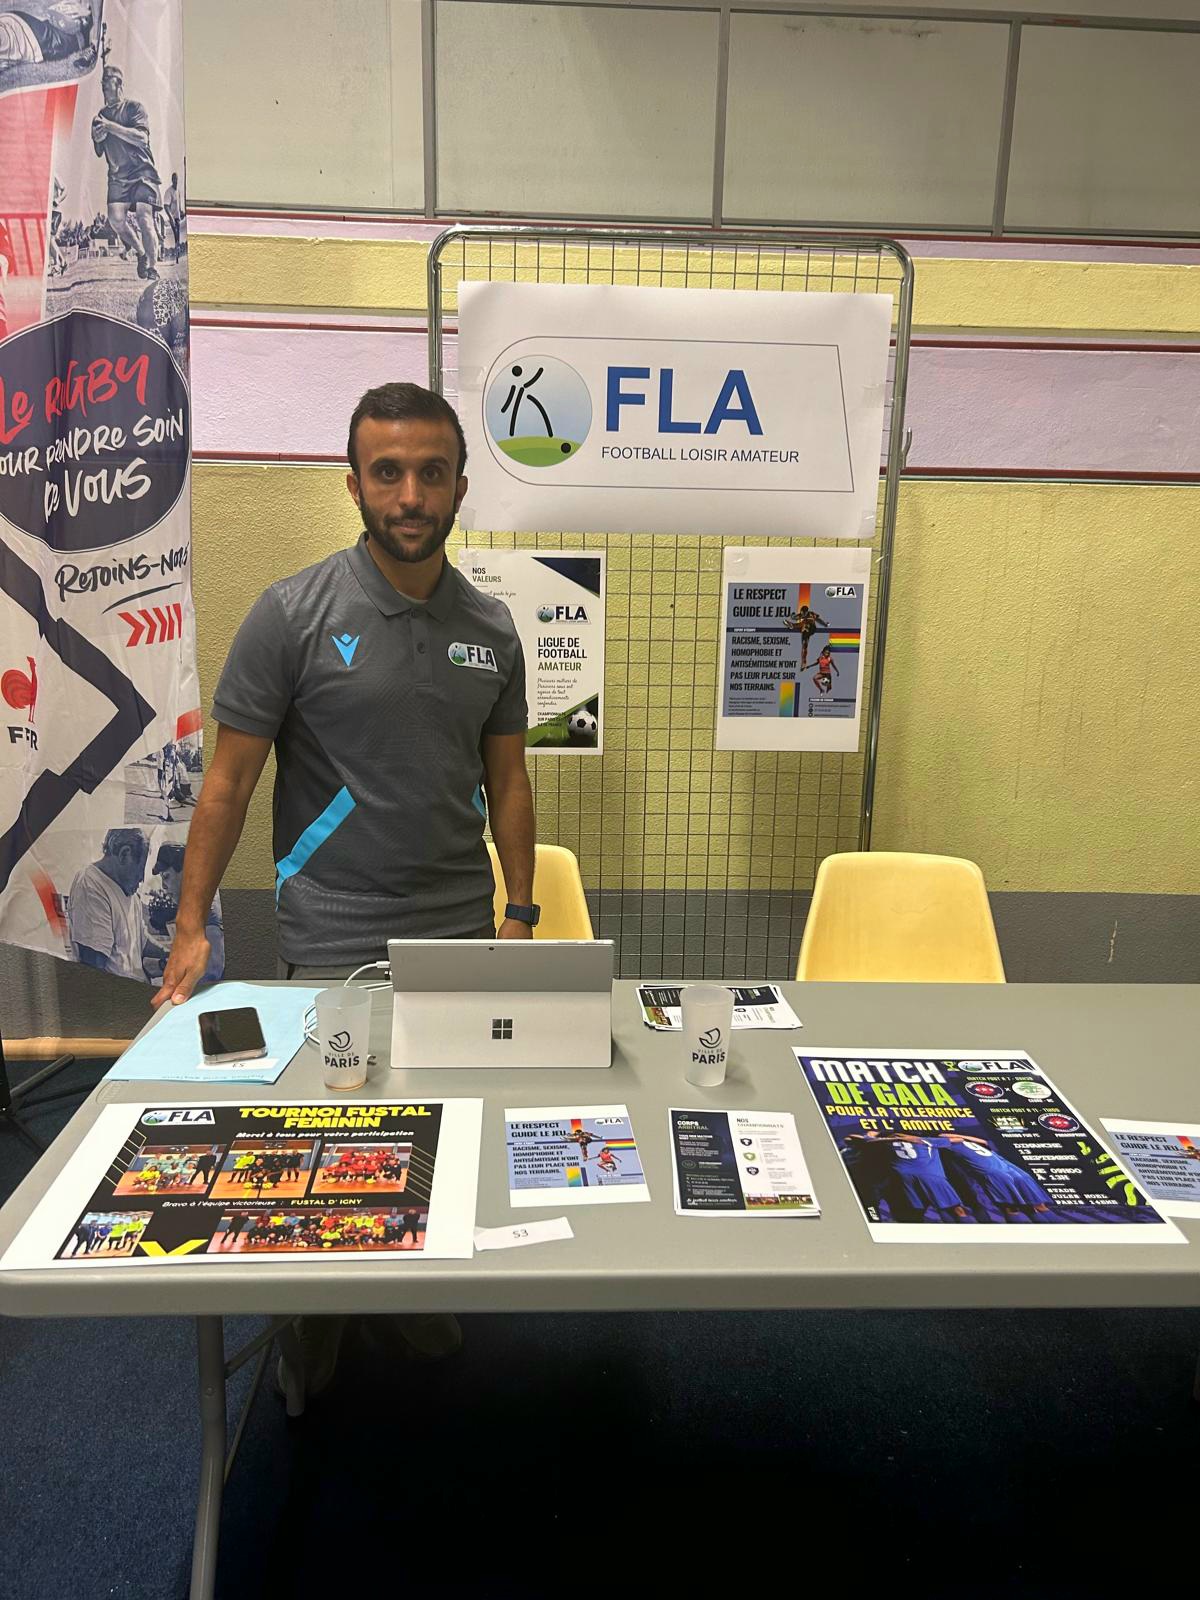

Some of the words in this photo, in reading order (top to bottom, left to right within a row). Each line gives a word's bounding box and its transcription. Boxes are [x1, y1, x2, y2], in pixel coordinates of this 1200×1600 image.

[605, 366, 764, 435] FLA
[602, 446, 676, 461] FOOTBALL
[680, 448, 728, 462] LOISIR
[730, 449, 799, 463] AMATEUR
[472, 567, 486, 575] NOS
[734, 588, 744, 600] LE
[746, 588, 787, 600] RESPECT
[836, 587, 855, 596] FLA
[555, 606, 587, 620] FLA
[733, 606, 760, 617] GUIDE
[763, 606, 774, 617] LE
[775, 606, 791, 618] JEU
[538, 637, 565, 648] LIGUE
[567, 637, 580, 647] DE
[732, 636, 761, 646] RACISME,
[762, 637, 790, 646] SEXISME,
[466, 646, 494, 666] FLA
[538, 649, 587, 659] FOOTBALL
[731, 648, 774, 657] HOMOPHOBIE
[537, 662, 582, 671] AMATEUR
[731, 659, 778, 668] ANTISÉMITISME
[779, 660, 797, 669] N'ONT
[730, 672, 743, 680] PAS
[744, 672, 759, 680] LEUR
[761, 672, 781, 680] PLACE
[782, 672, 795, 680] SUR
[730, 683, 742, 691] NOS
[325, 1056, 359, 1068] PARIS
[692, 1052, 725, 1064] PARIS
[810, 1060, 947, 1083] MATCH
[982, 1062, 1026, 1070] FLA
[825, 1082, 868, 1105] DE
[871, 1083, 958, 1106] GALA
[168, 1111, 212, 1122] FLA
[239, 1107, 342, 1118] TOURNOI
[346, 1106, 432, 1117] FUSTAL
[825, 1105, 867, 1116] POUR
[868, 1107, 888, 1117] LA
[890, 1107, 975, 1118] TOLERANCE
[283, 1117, 380, 1129] FEMININ
[860, 1119, 878, 1130] ET
[881, 1120, 894, 1130] L'
[900, 1120, 955, 1131] AMITIE
[350, 1130, 415, 1138] participation
[1127, 1135, 1167, 1143] RESPECT
[892, 1142, 917, 1160] 3
[962, 1141, 993, 1157] 9
